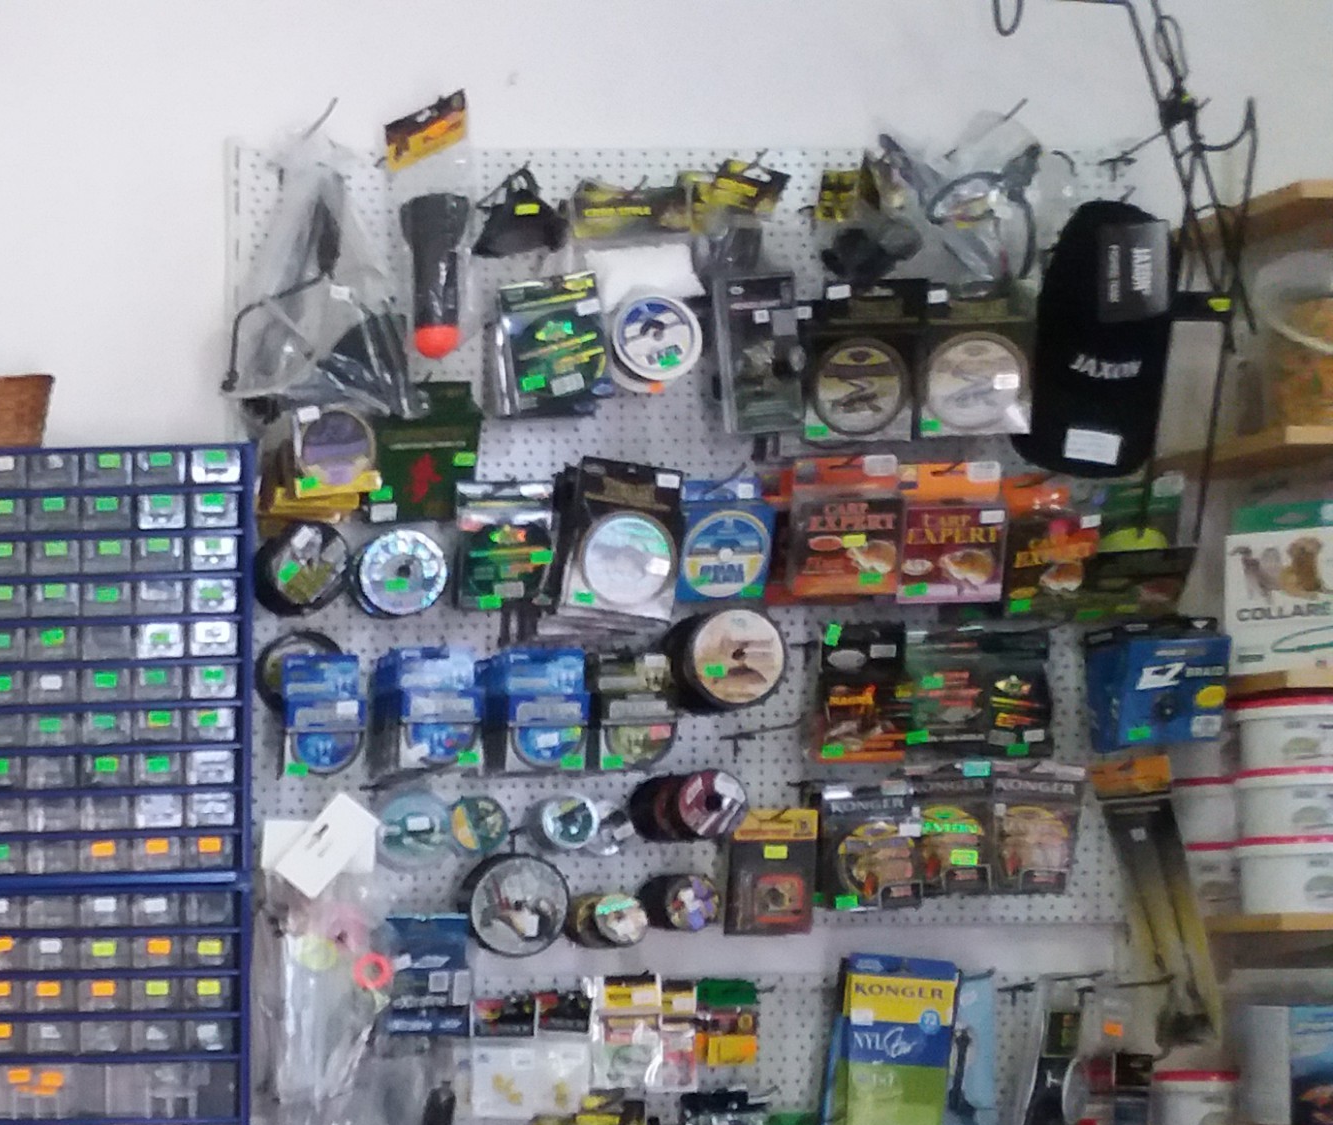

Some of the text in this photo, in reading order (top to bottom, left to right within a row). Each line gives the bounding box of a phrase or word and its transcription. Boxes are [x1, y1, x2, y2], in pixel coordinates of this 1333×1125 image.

[906, 526, 1002, 545] EXPERT
[994, 778, 1077, 796] KONGER
[854, 982, 944, 1000] KONGER
